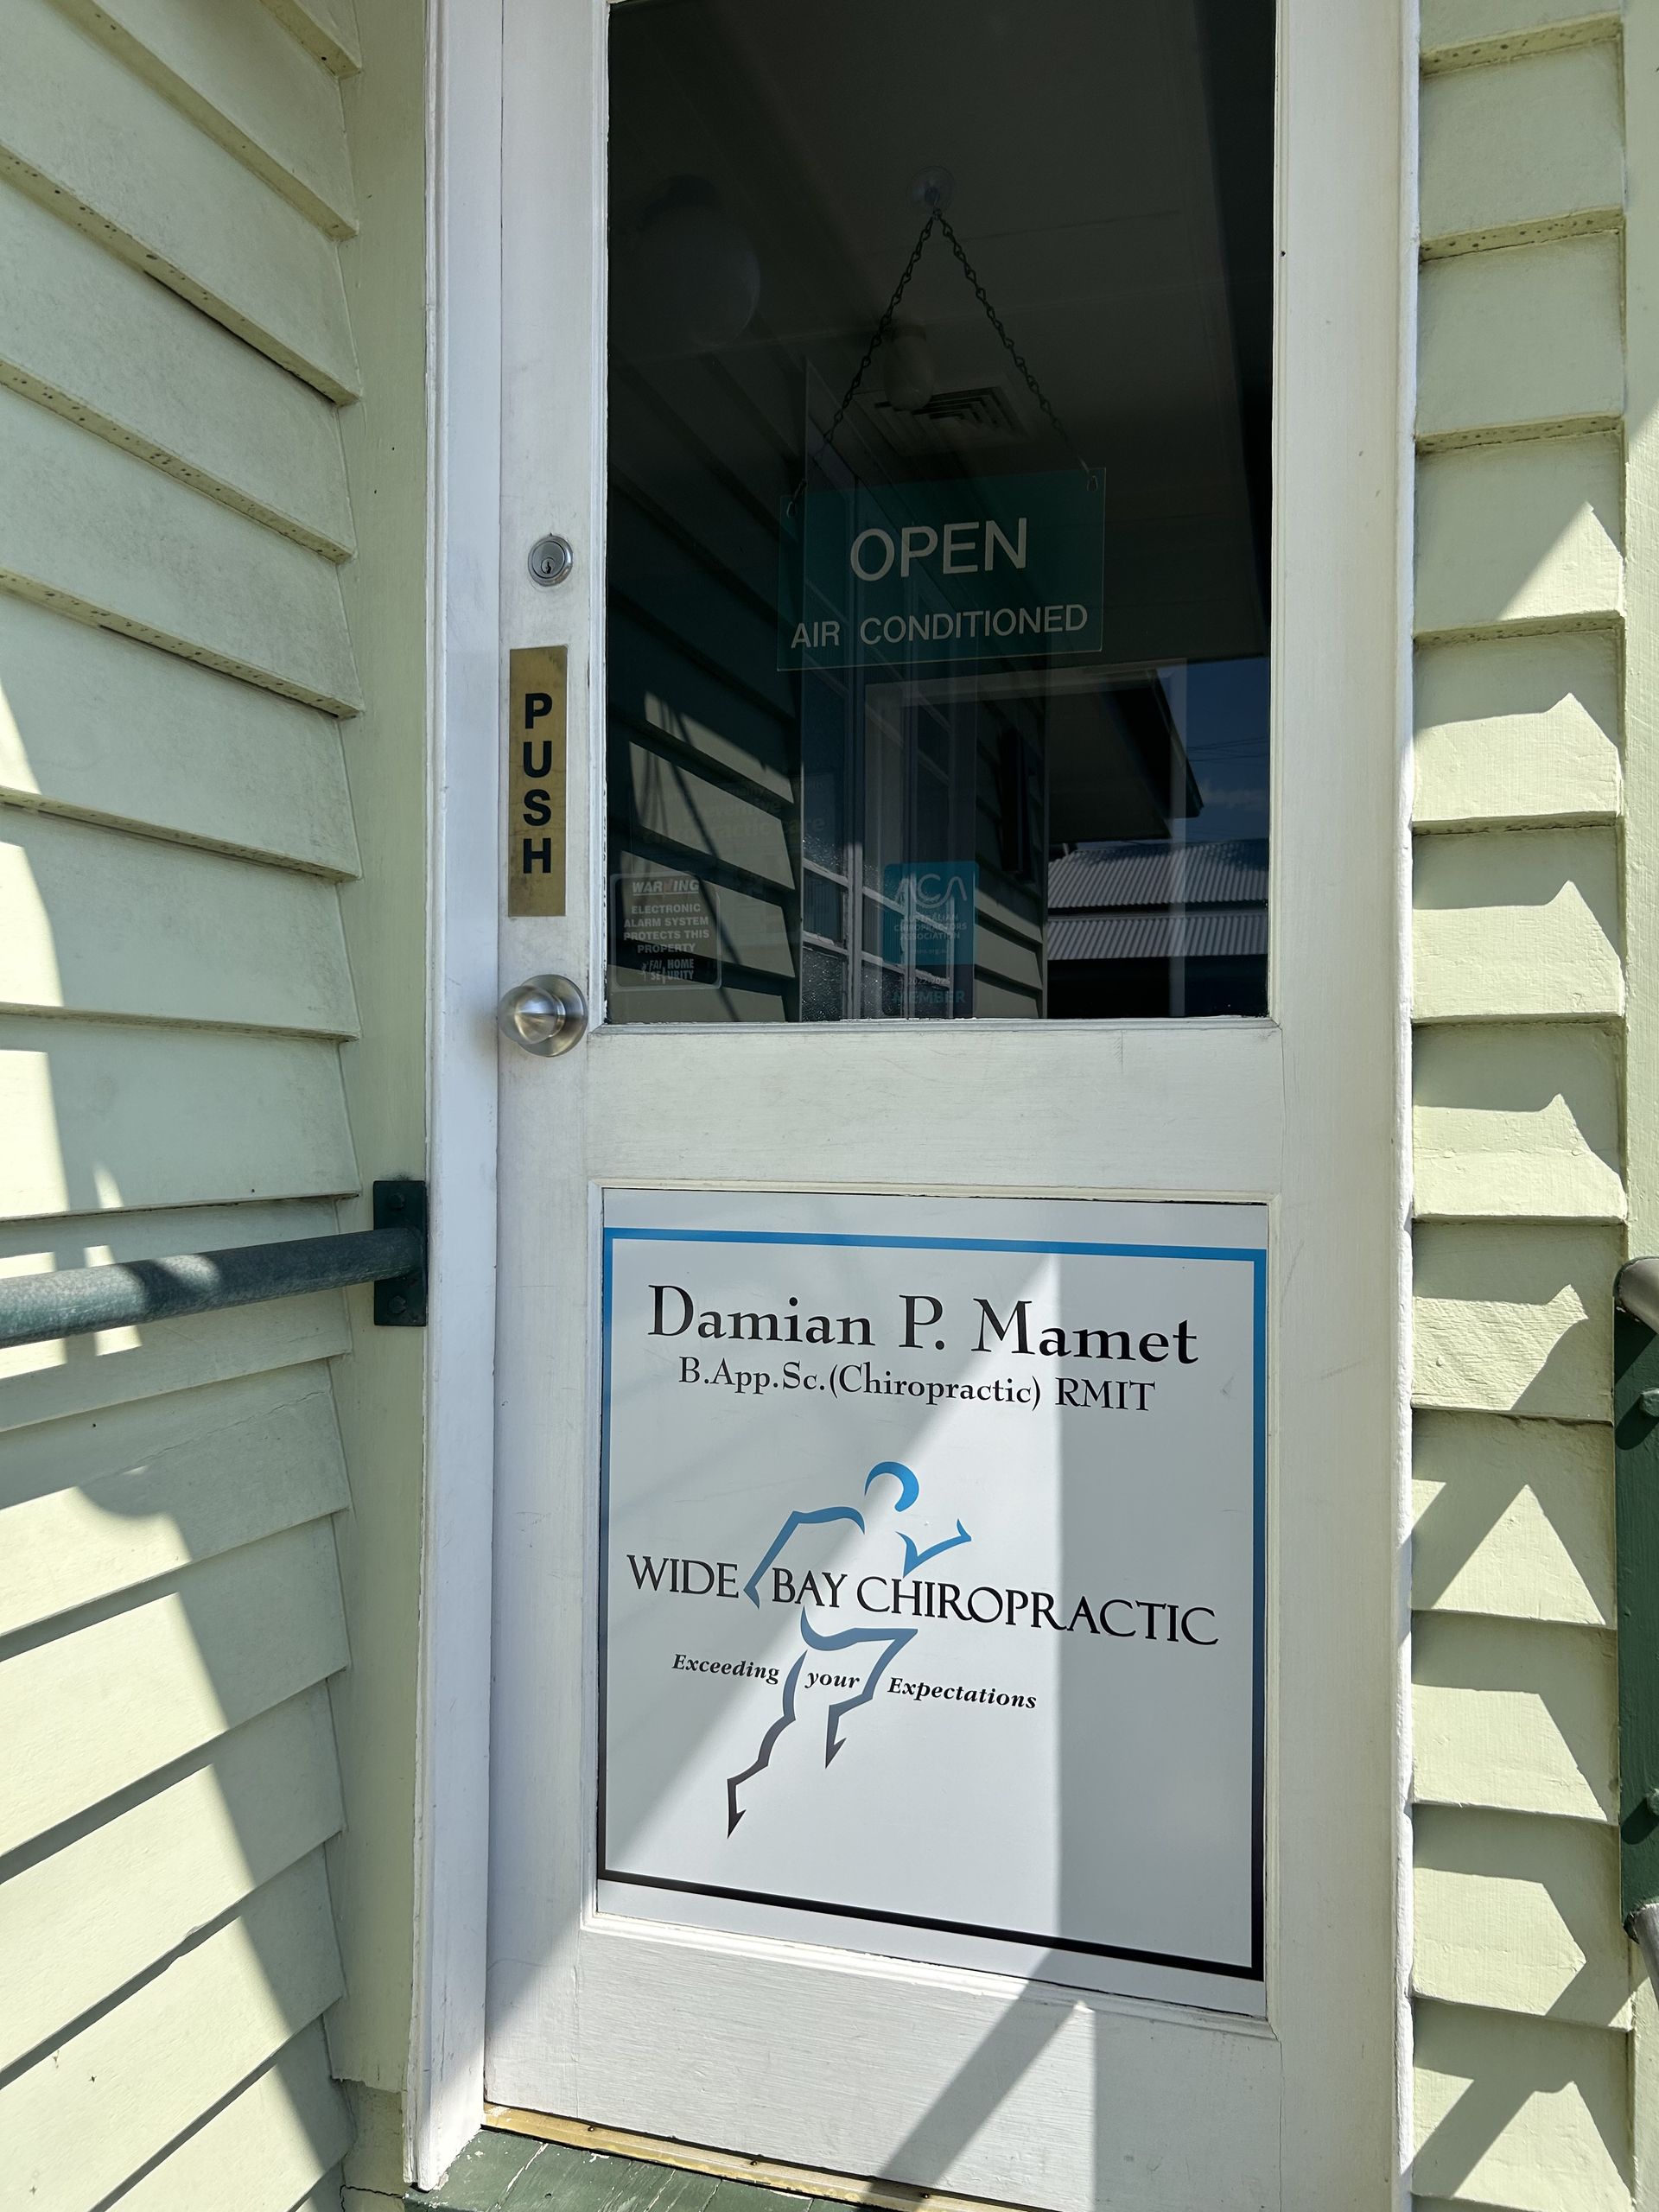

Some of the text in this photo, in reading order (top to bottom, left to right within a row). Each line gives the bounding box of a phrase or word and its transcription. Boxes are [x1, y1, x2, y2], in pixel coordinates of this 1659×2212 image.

[850, 517, 1028, 582] OPEN
[791, 603, 1089, 649] AIR CONDITIONED
[522, 692, 553, 874] PUSH
[623, 917, 709, 928] ALARM SYSTEM
[632, 903, 702, 914] ELECTRONIC
[623, 929, 710, 941] PROTECTS THIS
[637, 943, 696, 954] PROPERTY
[667, 958, 695, 969] HOME
[646, 1284, 1199, 1365] Damian P. Mamet
[678, 1356, 1156, 1412] B.App.Sc.(Chiropractic) RMIT
[626, 1554, 1219, 1646] WIDE BAY CHIROPRACTIC
[671, 1653, 1038, 1709] Exceeding your Expectations
